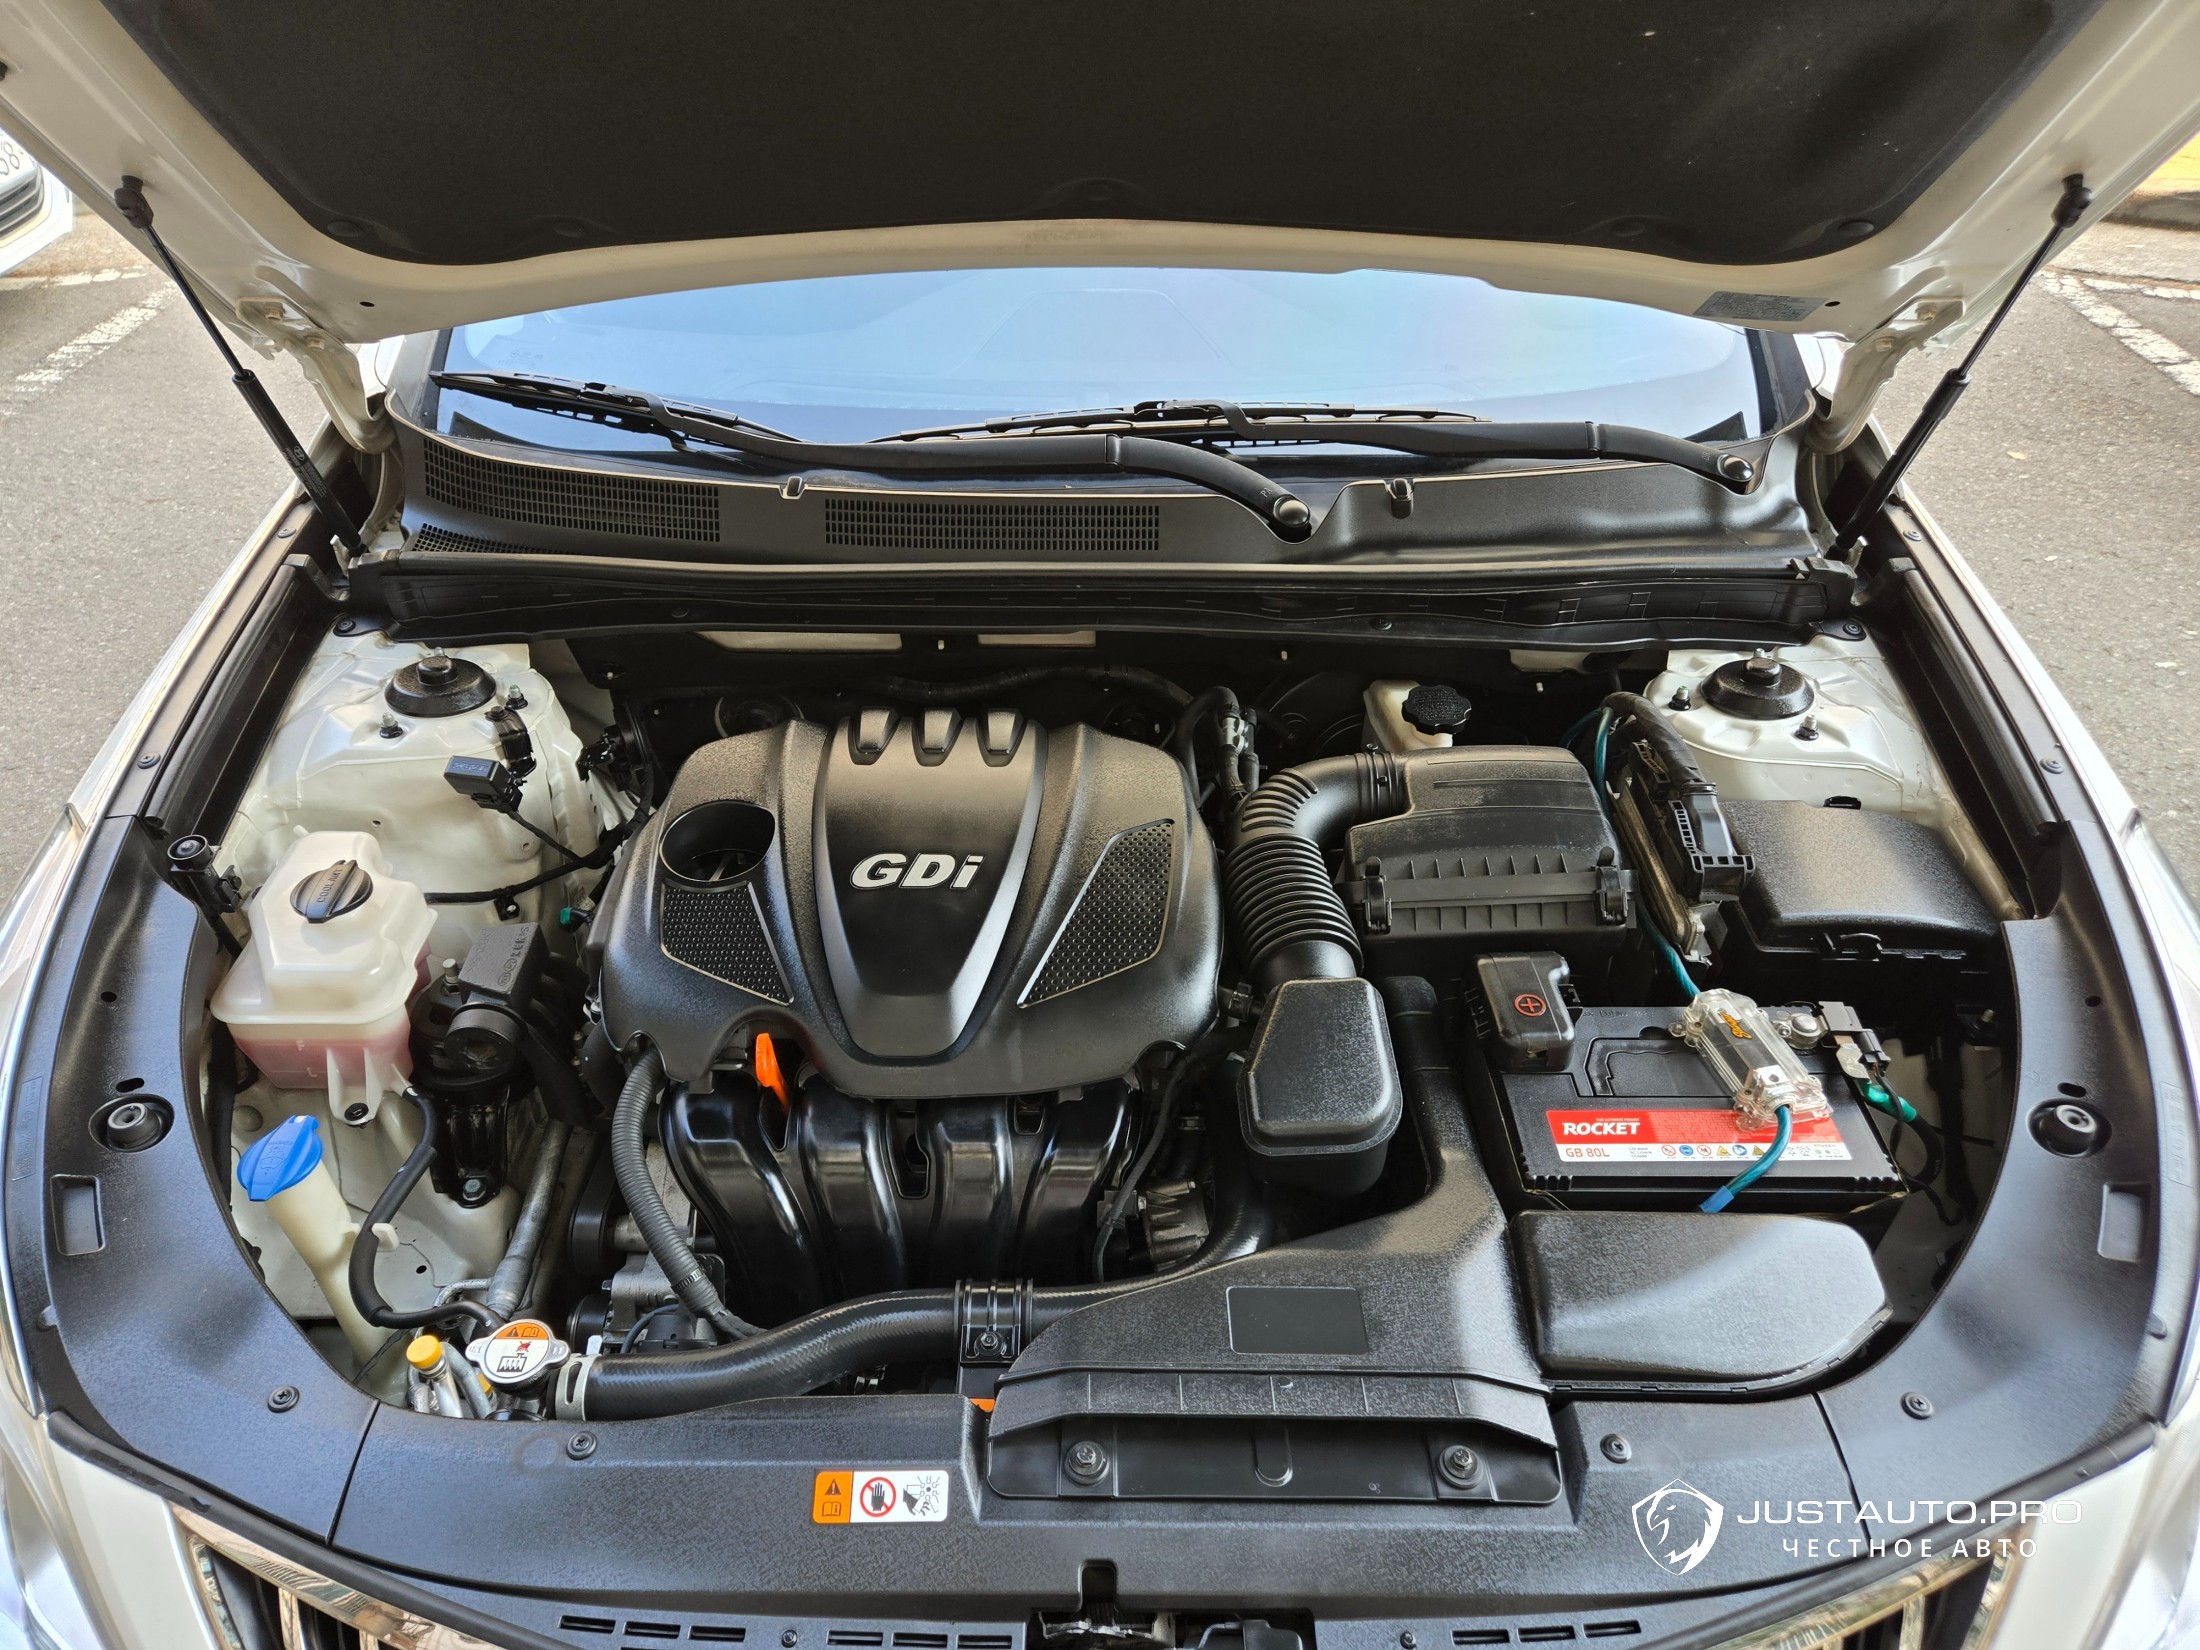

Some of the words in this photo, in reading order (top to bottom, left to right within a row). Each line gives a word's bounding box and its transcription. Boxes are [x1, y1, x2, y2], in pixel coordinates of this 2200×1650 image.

[850, 852, 986, 890] GDi
[316, 868, 344, 904] COOLANT
[1562, 1121, 1641, 1137] ROCKET
[1565, 1147, 1584, 1159] GB
